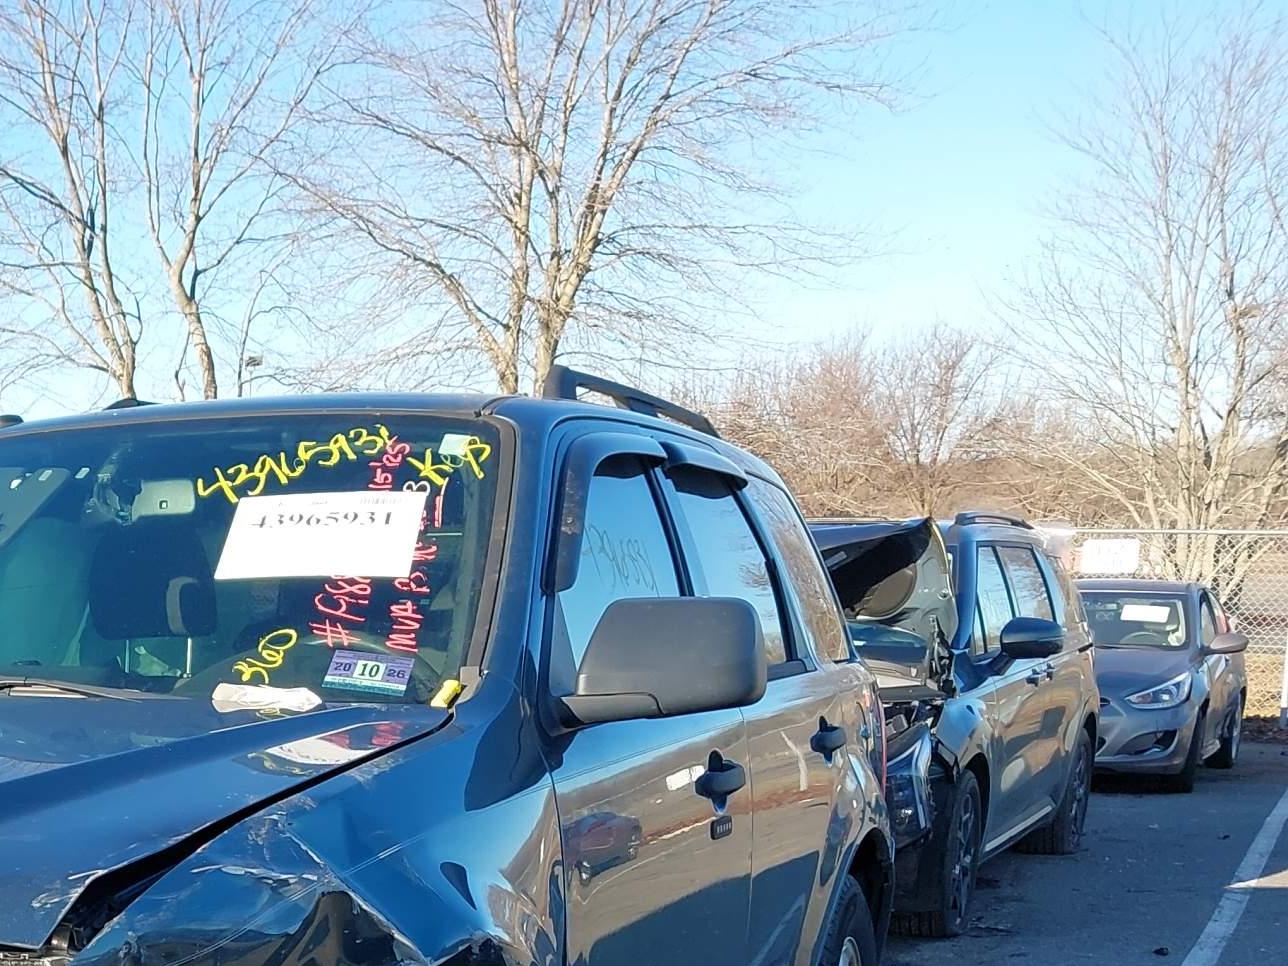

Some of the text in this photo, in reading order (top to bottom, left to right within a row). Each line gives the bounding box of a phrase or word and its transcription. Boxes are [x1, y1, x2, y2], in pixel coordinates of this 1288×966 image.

[334, 662, 405, 679] 20 10 26
